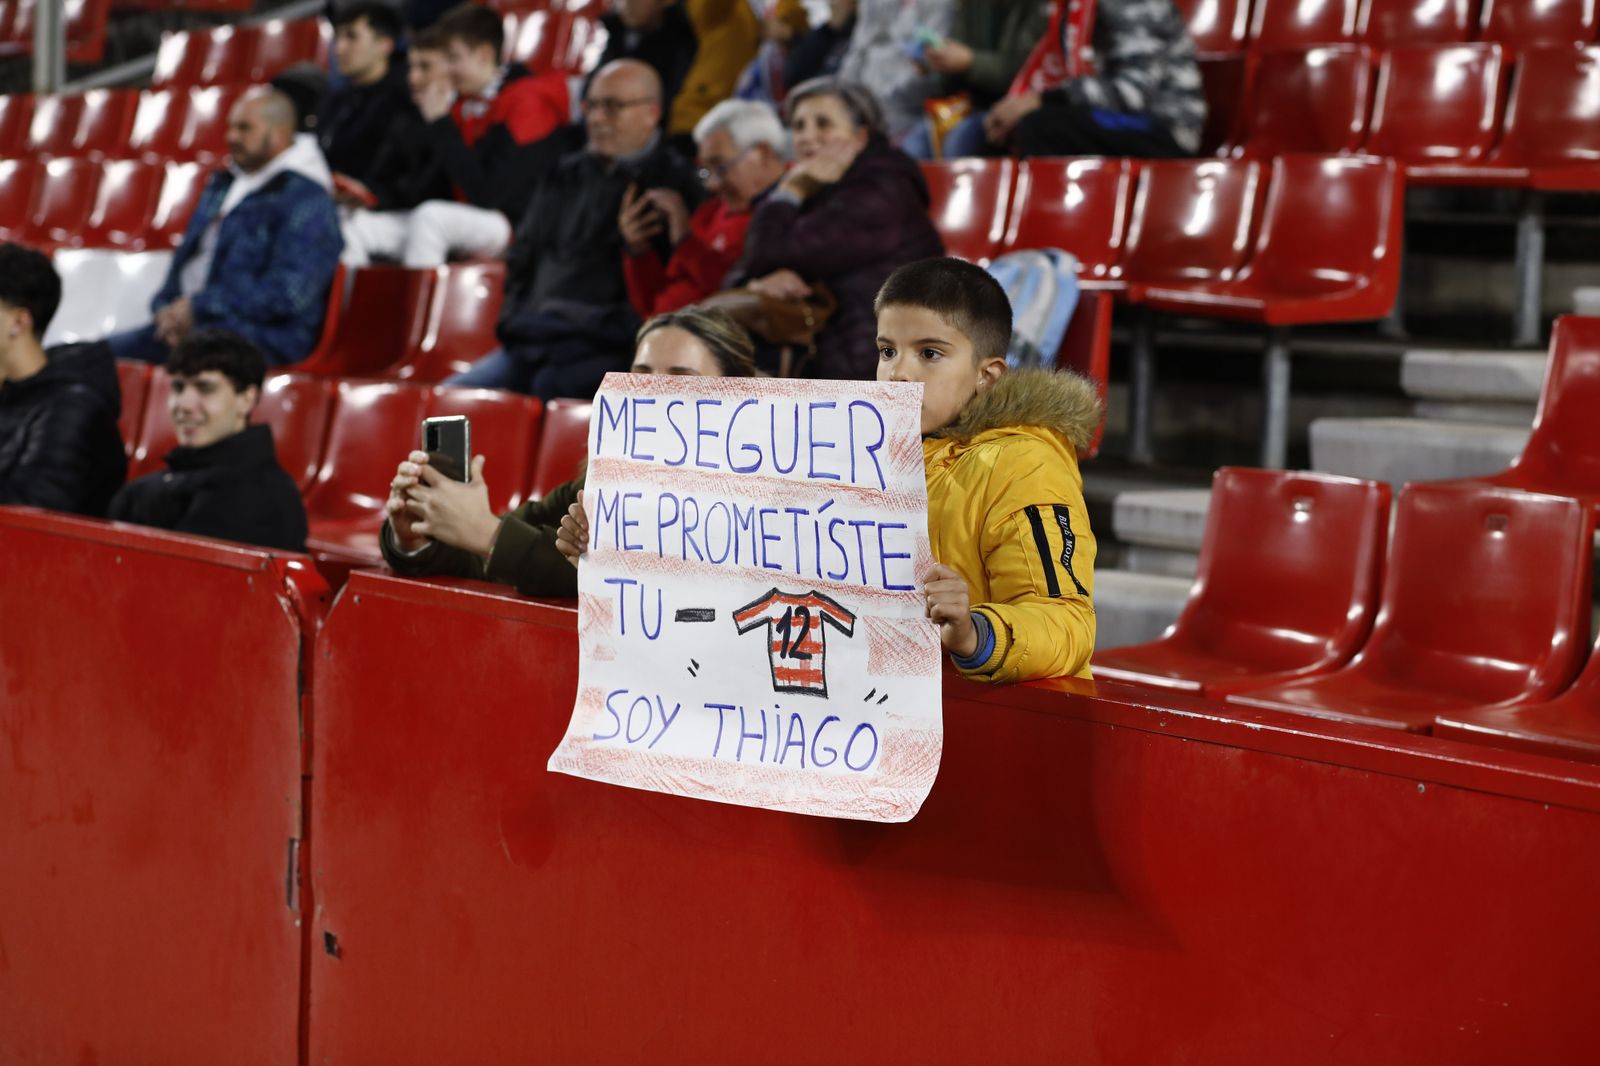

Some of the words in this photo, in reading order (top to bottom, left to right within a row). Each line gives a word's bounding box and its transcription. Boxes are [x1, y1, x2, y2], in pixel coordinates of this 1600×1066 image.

[597, 394, 887, 491] MESEGUER
[594, 488, 643, 551] ME
[657, 493, 915, 591] PROMETÍSTE
[1058, 514, 1073, 537] BLUE
[603, 578, 663, 640] TU
[775, 605, 813, 660] 12
[592, 689, 681, 749] SOY
